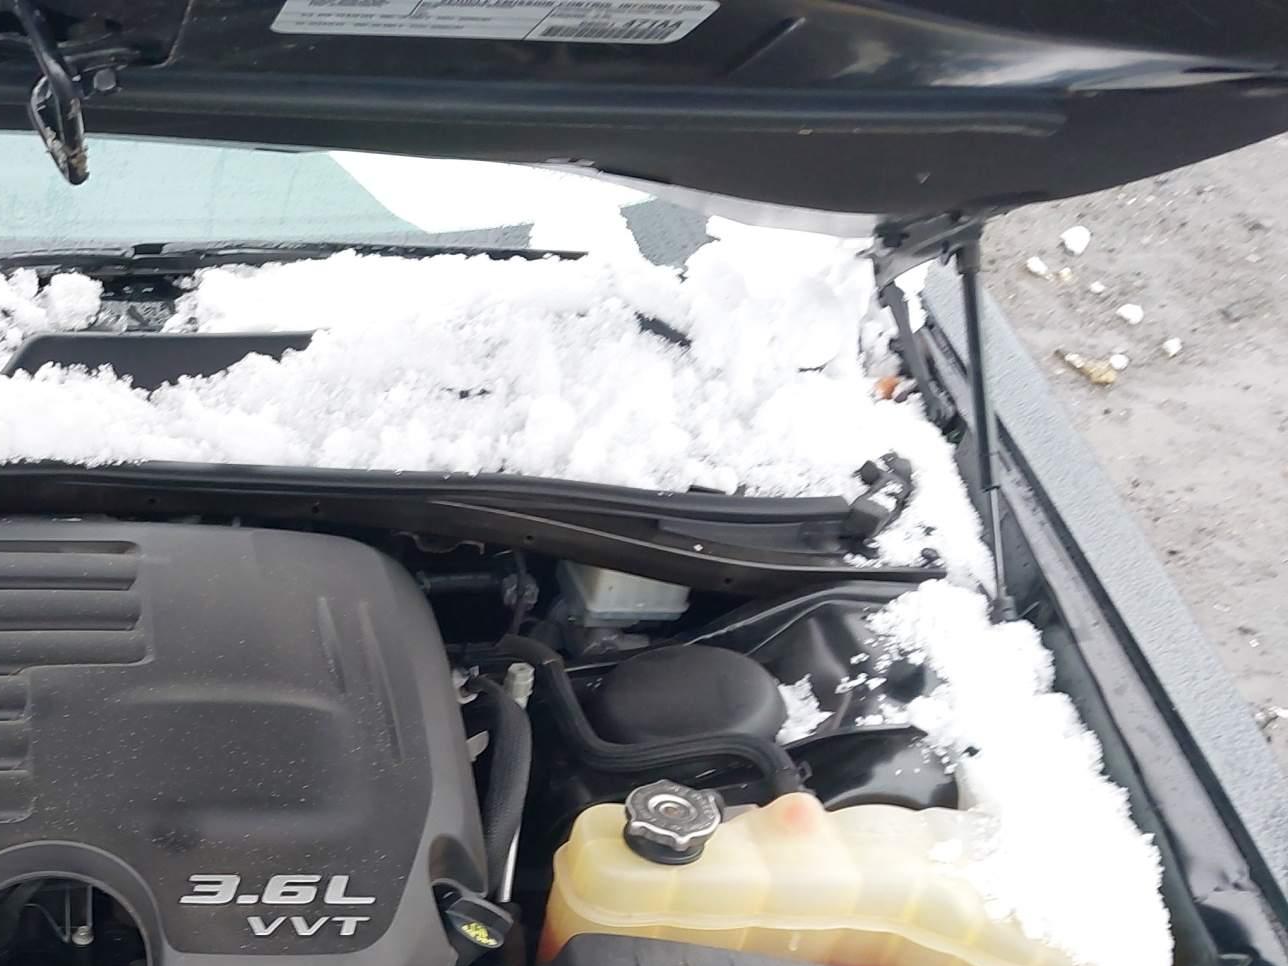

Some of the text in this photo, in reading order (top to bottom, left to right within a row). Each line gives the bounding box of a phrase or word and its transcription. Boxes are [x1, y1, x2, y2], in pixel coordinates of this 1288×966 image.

[618, 3, 705, 11] INFORMATION
[179, 874, 376, 905] 3.6L
[247, 916, 371, 936] VVT
